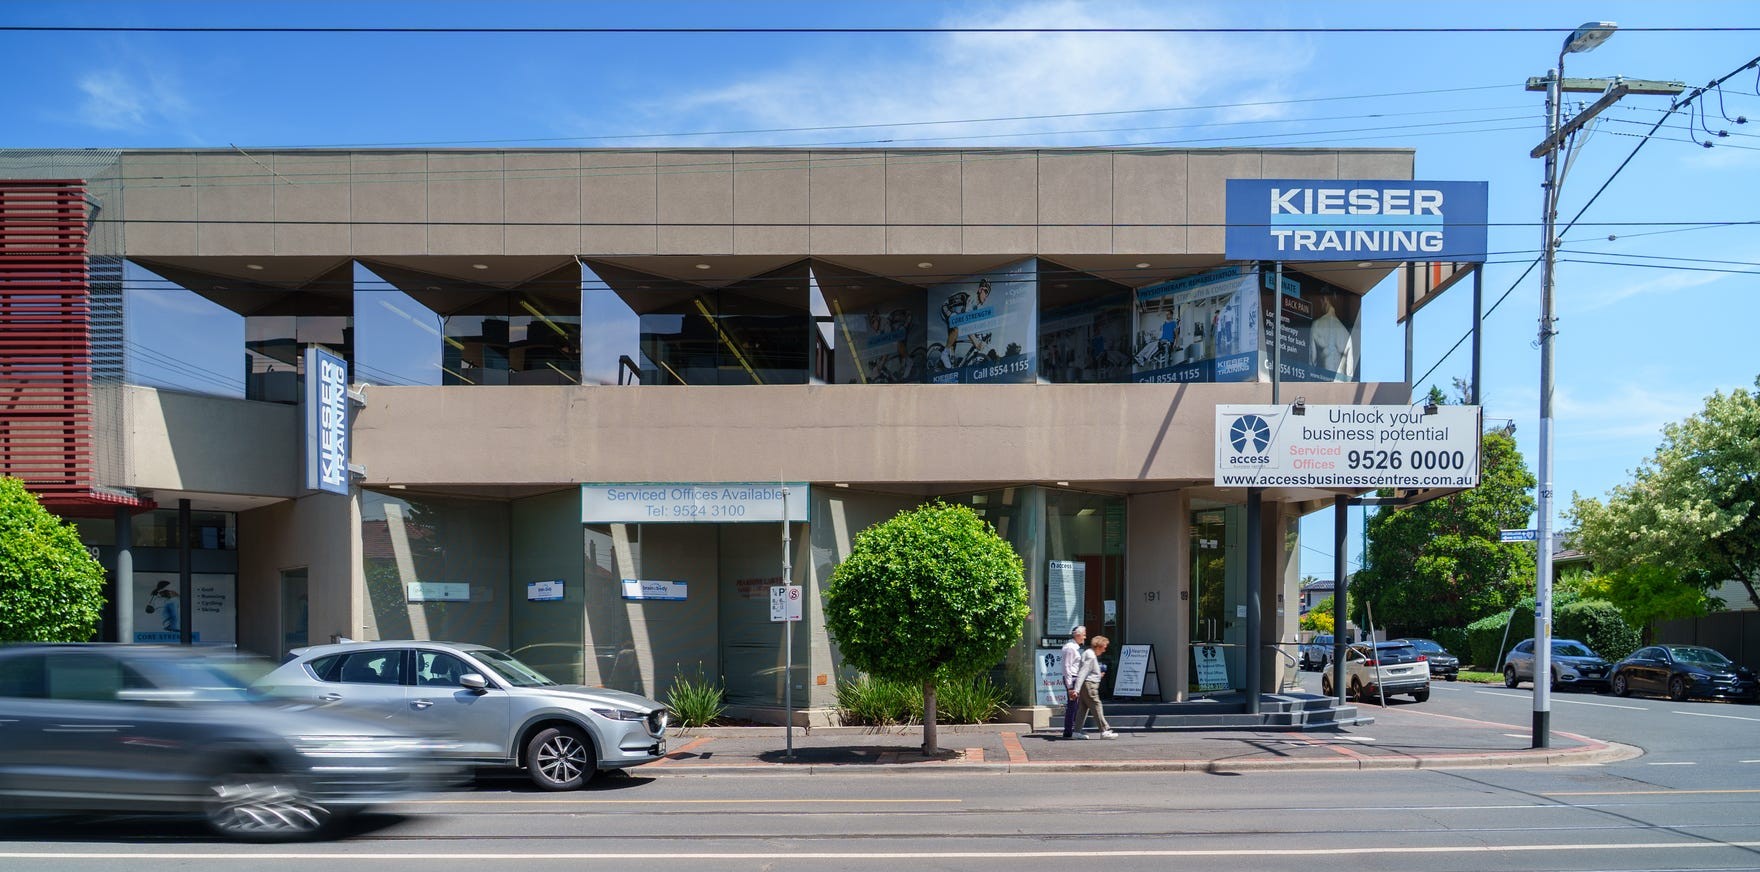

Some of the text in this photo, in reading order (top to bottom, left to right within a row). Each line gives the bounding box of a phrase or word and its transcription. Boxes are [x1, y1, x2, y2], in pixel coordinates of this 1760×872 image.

[1271, 188, 1444, 216] KIESER
[1270, 230, 1444, 252] TRAINING
[1284, 298, 1309, 314] BACK PAIN
[965, 309, 992, 321] STRENGTH
[1287, 345, 1298, 353] pain
[973, 367, 988, 380] Call
[989, 364, 1008, 377] 8554
[1010, 360, 1029, 373] 1155
[1156, 373, 1177, 383] 8554
[1179, 368, 1200, 380] 1155
[1292, 366, 1305, 379] 1155
[321, 359, 333, 484] KIESER
[1329, 409, 1424, 427] Unlock your
[336, 366, 345, 485] TRAINING
[1303, 426, 1448, 444] business potential
[1289, 445, 1341, 456] Serviced
[1230, 455, 1270, 464] access
[1293, 458, 1335, 470] Offices
[1347, 450, 1464, 470] 9526 0000
[1223, 473, 1472, 485] www.accessbusinesscentres.com.au
[607, 488, 783, 501] Serviced Offices Available
[646, 505, 745, 517] Tel: 9524 3100
[778, 588, 785, 596] P
[1144, 590, 1160, 601] 191
